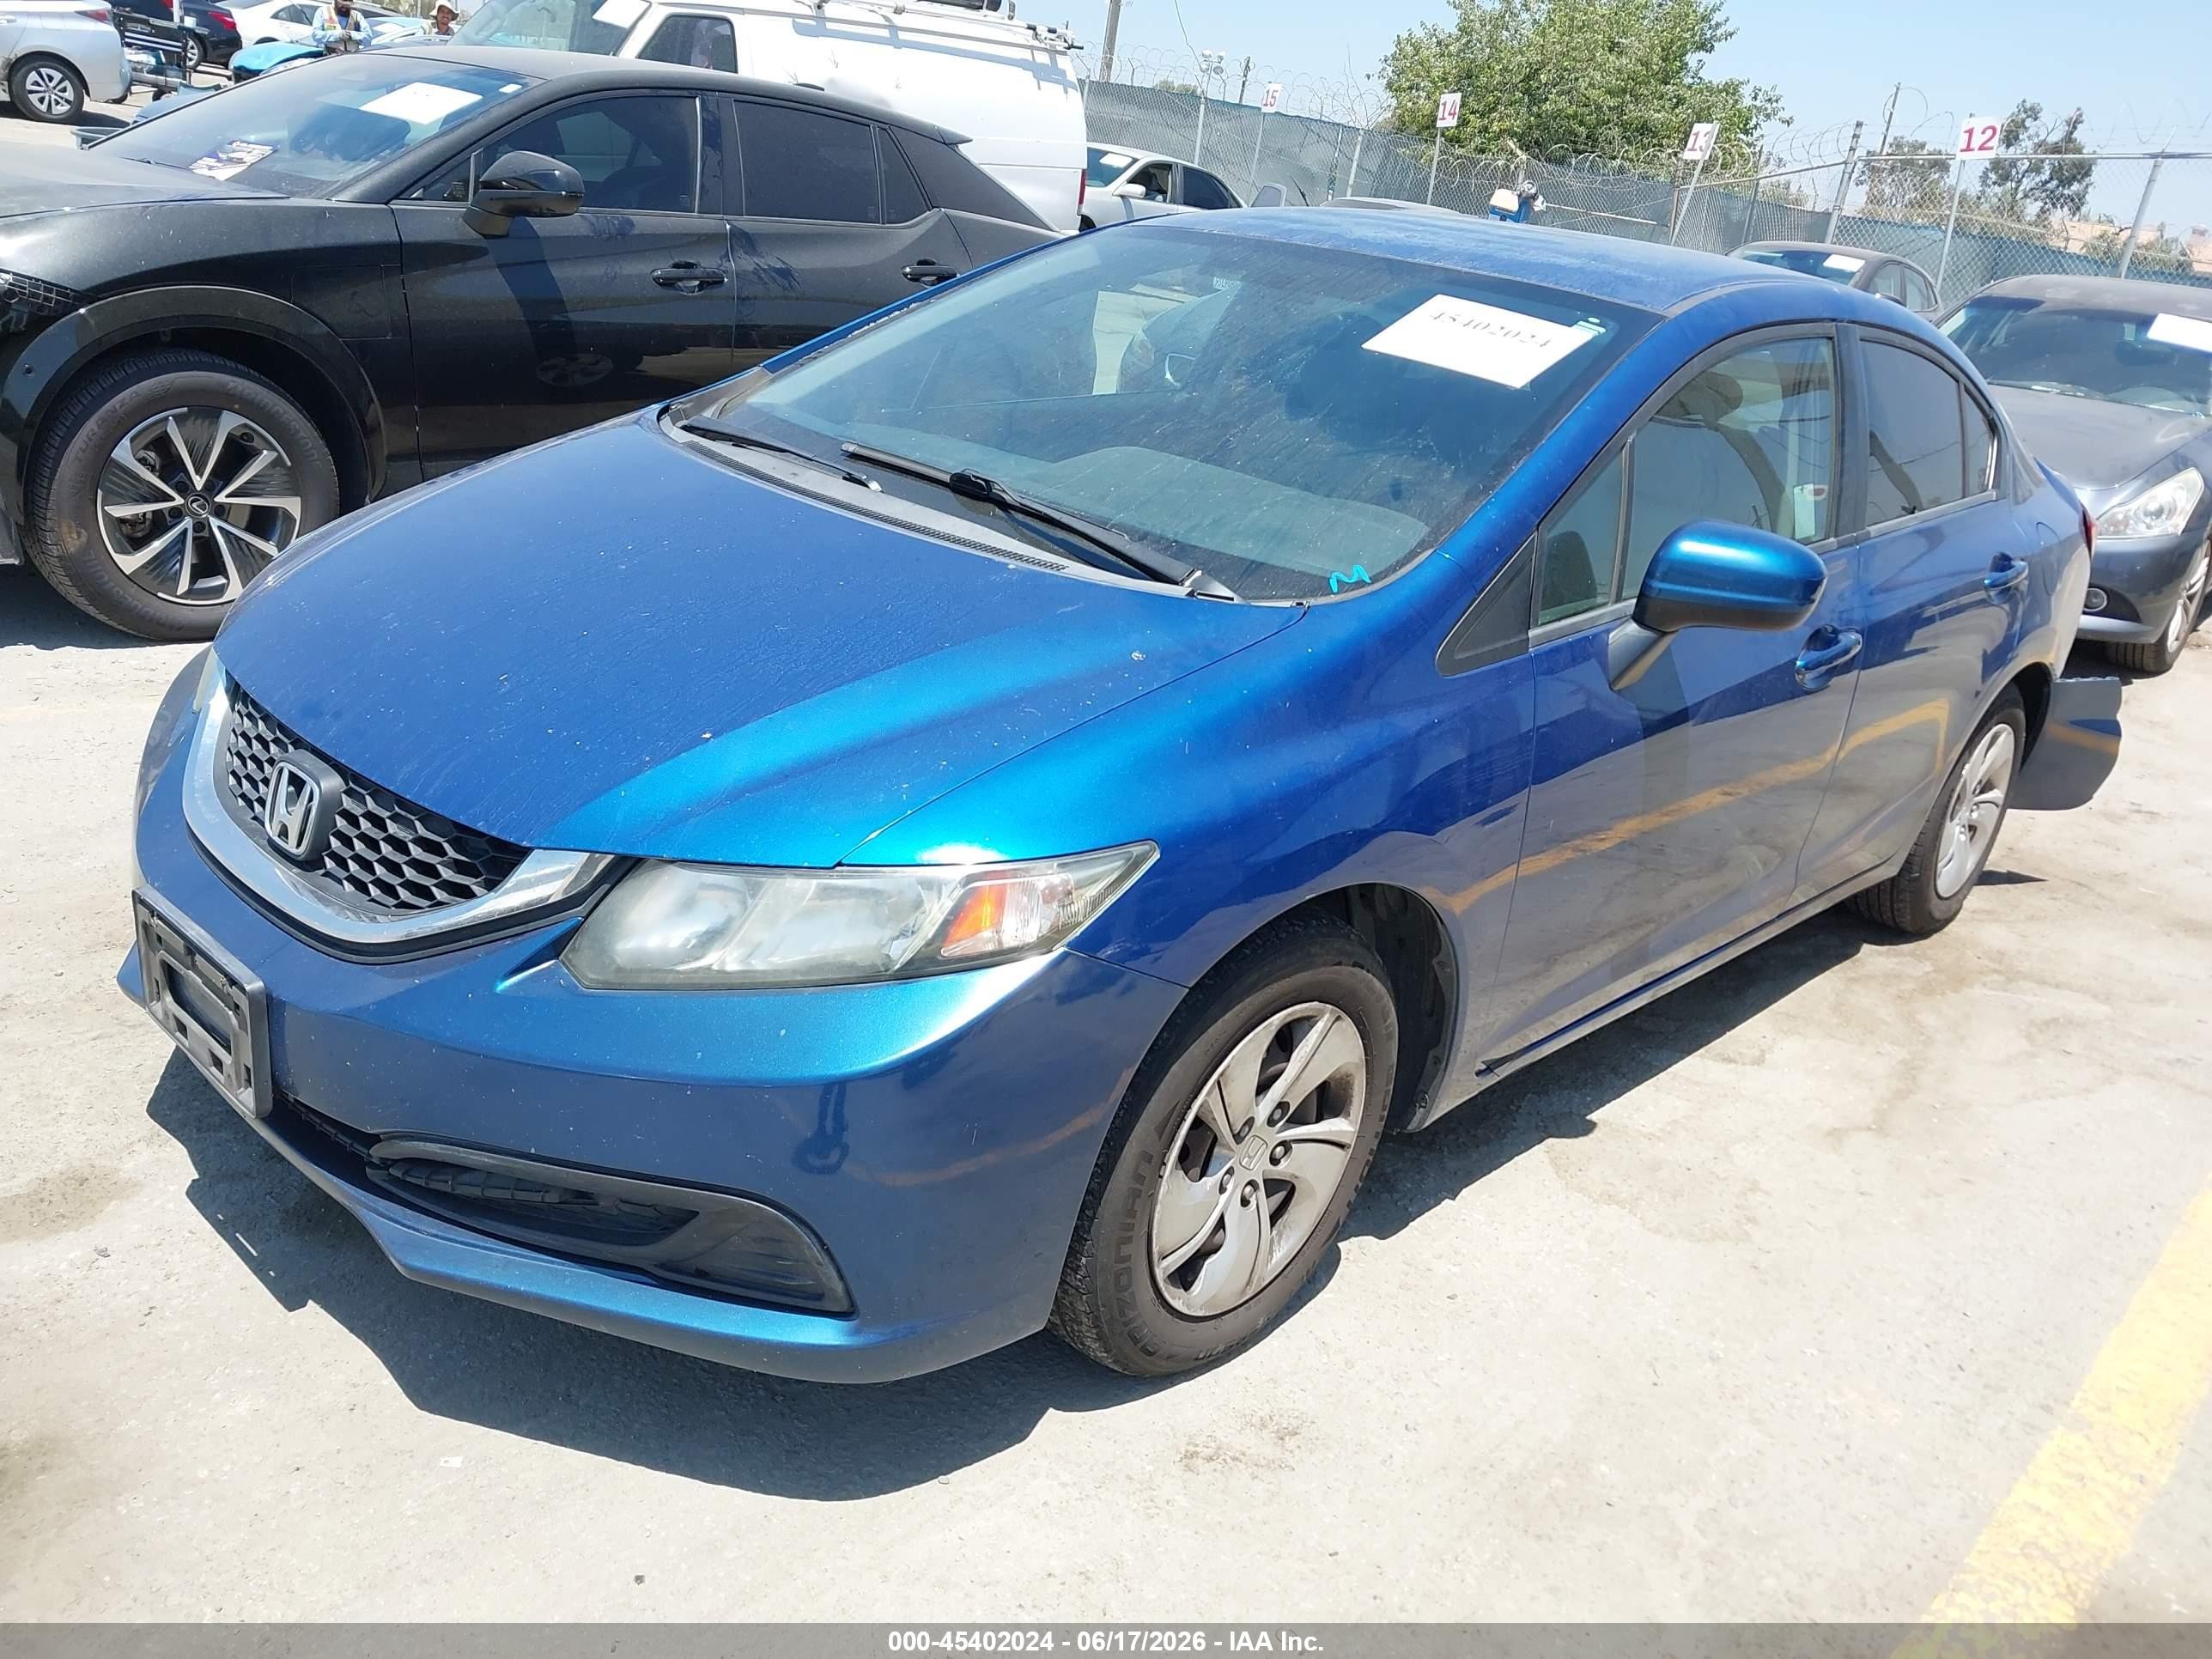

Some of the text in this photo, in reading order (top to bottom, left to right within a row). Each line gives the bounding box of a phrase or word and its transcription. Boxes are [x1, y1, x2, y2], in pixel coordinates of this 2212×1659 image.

[1262, 88, 1279, 107] 15
[1438, 99, 1458, 121] 14
[1959, 125, 1998, 153] 12
